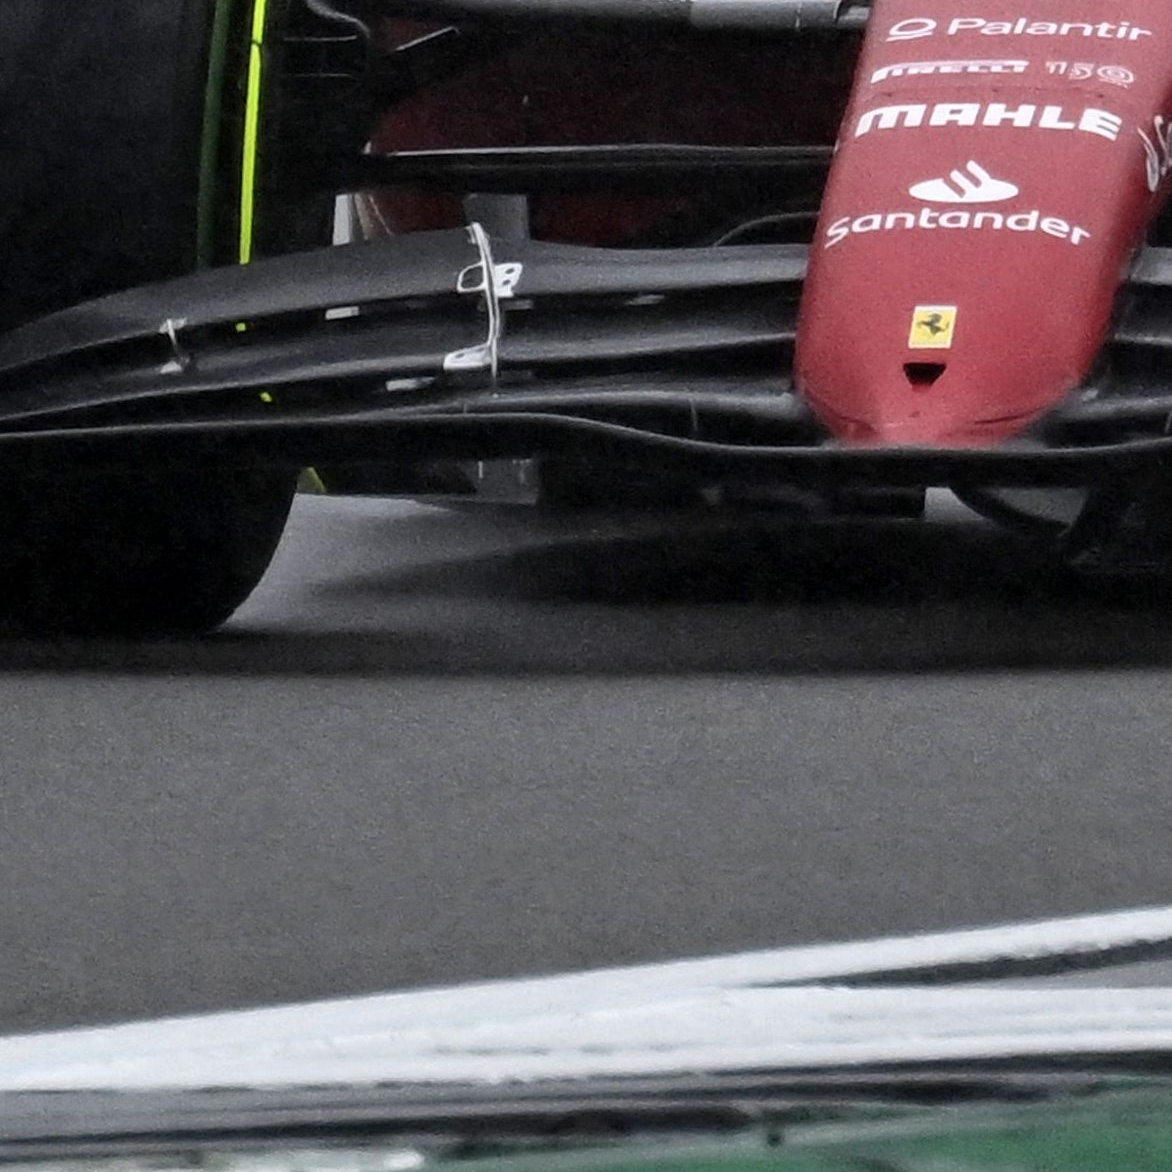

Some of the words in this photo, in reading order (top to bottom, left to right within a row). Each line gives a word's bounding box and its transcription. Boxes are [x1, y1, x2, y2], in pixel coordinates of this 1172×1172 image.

[947, 18, 1153, 41] Palantir
[871, 59, 1030, 84] PIRELLI
[855, 102, 1123, 141] MAHLE
[824, 207, 1092, 249] Santander
